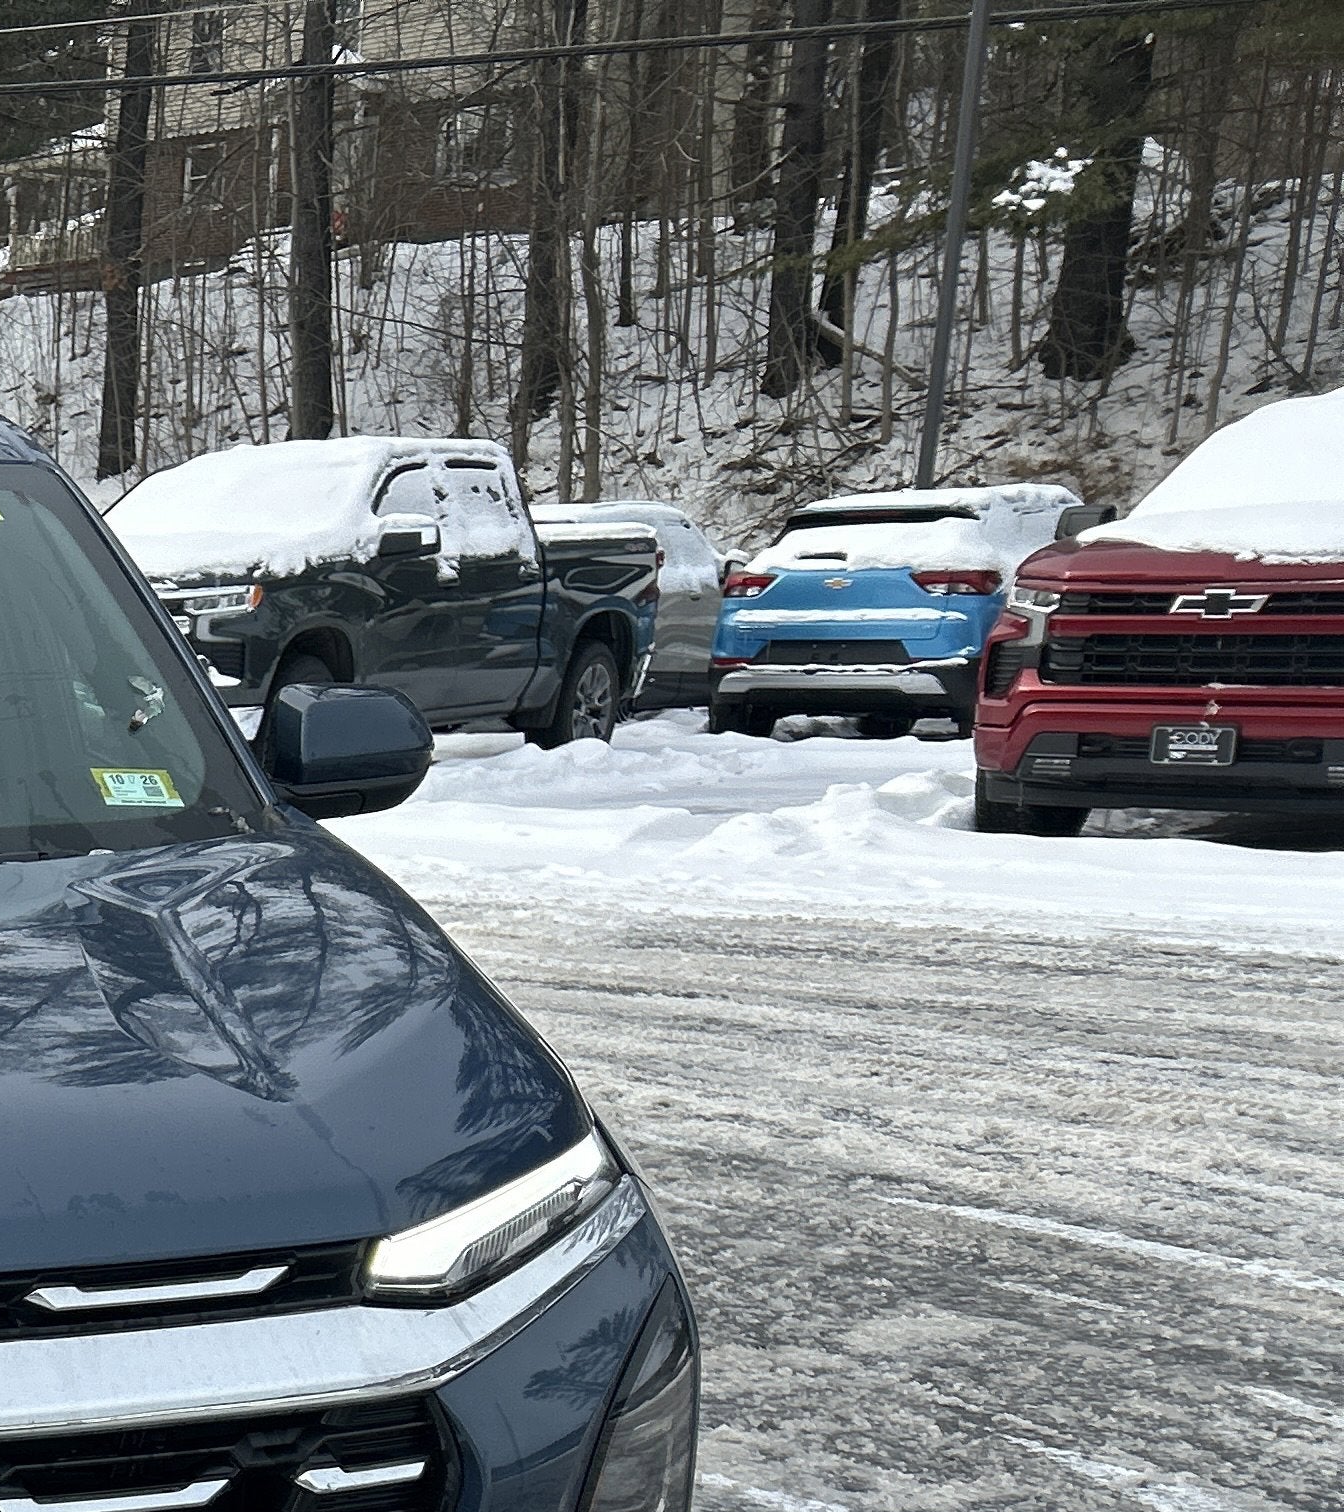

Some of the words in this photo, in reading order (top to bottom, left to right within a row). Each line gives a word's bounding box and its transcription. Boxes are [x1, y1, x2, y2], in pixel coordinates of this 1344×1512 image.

[1173, 731, 1221, 745] CODY
[108, 774, 125, 785] 10
[140, 775, 159, 786] 26
